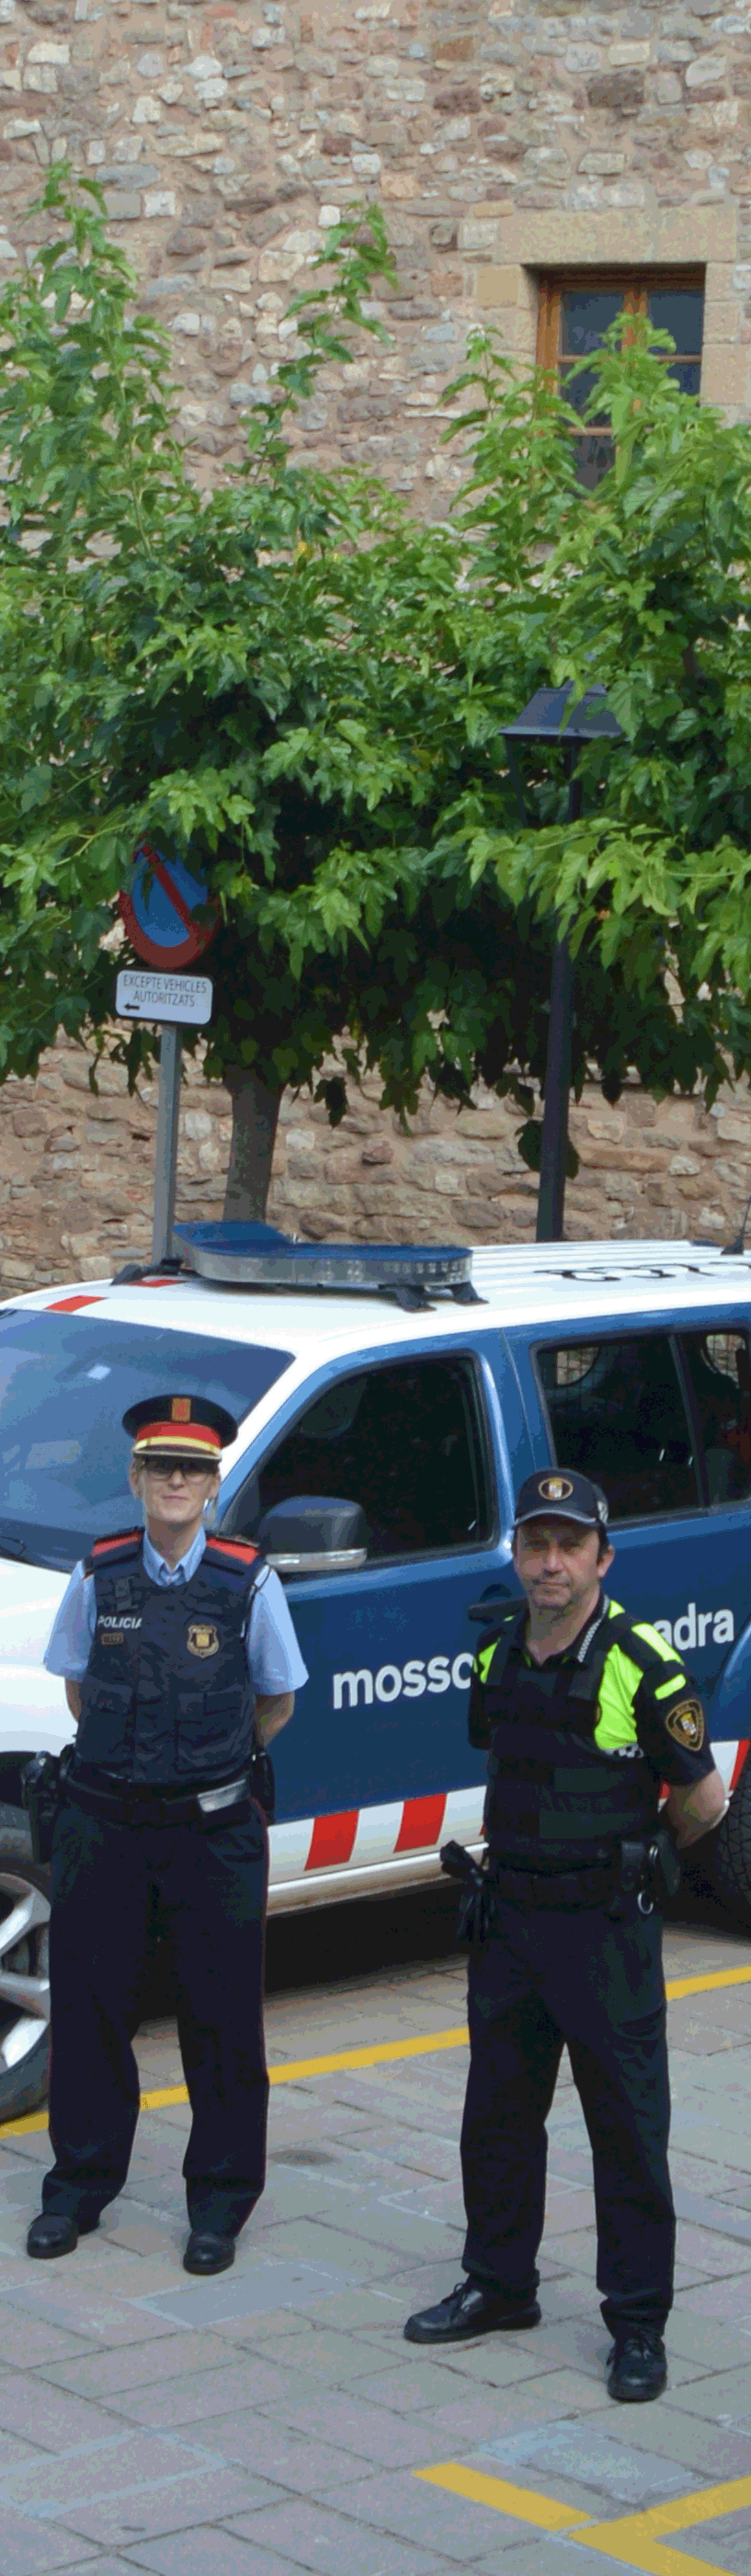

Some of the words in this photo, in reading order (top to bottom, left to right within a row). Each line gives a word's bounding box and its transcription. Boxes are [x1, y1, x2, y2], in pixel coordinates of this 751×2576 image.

[123, 975, 162, 990] EXCEPTE
[164, 978, 207, 994] VEHICLES
[133, 990, 195, 1008] AUTORITZATS
